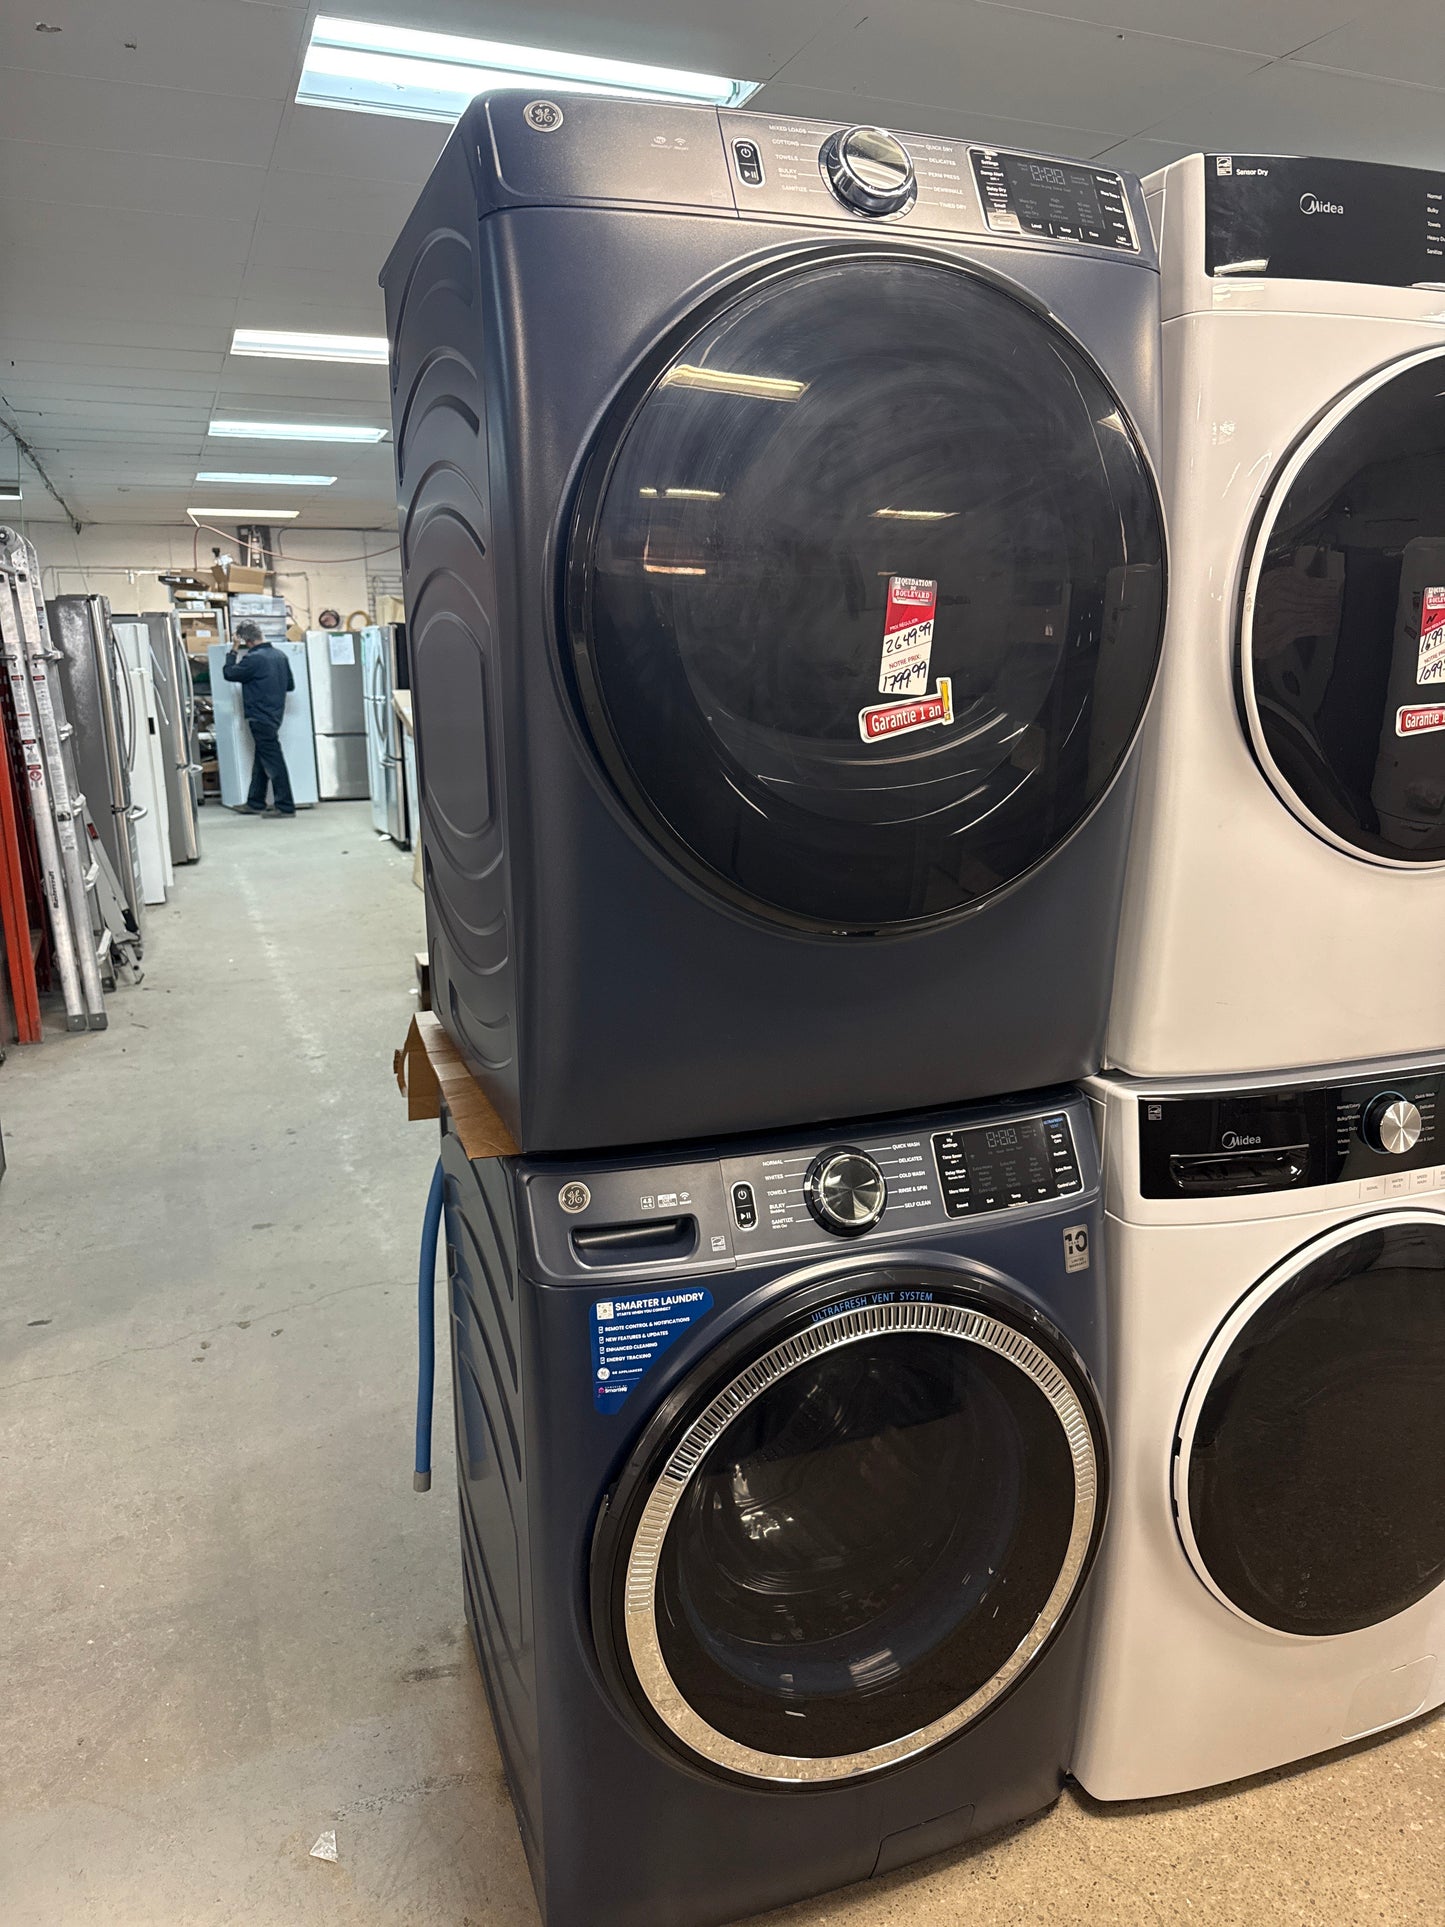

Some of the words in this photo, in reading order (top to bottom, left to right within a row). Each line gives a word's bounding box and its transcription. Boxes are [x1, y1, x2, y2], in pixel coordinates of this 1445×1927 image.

[1236, 168, 1256, 176] Sensor
[1257, 168, 1269, 176] Dry
[1300, 192, 1344, 215] Midea
[895, 577, 932, 587] LIQUIDATION
[895, 589, 930, 599] BOULEVARD
[885, 621, 931, 653] 2649.99
[889, 657, 907, 669] NOTRE
[883, 661, 927, 692] 1799.99
[871, 710, 917, 733] Garantie
[920, 706, 926, 720] 1
[929, 705, 942, 718] an
[1405, 712, 1439, 729] Garantie
[1221, 1131, 1261, 1149] Midea
[771, 1217, 793, 1225] SANITIZE
[1065, 1230, 1087, 1254] 10
[615, 1298, 659, 1311] SMARTER
[661, 1292, 704, 1305] LAUNDRY
[811, 1296, 867, 1322] ULTRAFRESH
[871, 1291, 895, 1303] VENT
[899, 1291, 933, 1301] SYSTEM
[625, 1322, 648, 1330] CONTROL
[653, 1317, 690, 1326] NOTIFICATIONS
[617, 1333, 641, 1341] FEATURES
[646, 1330, 668, 1338] UPDATES
